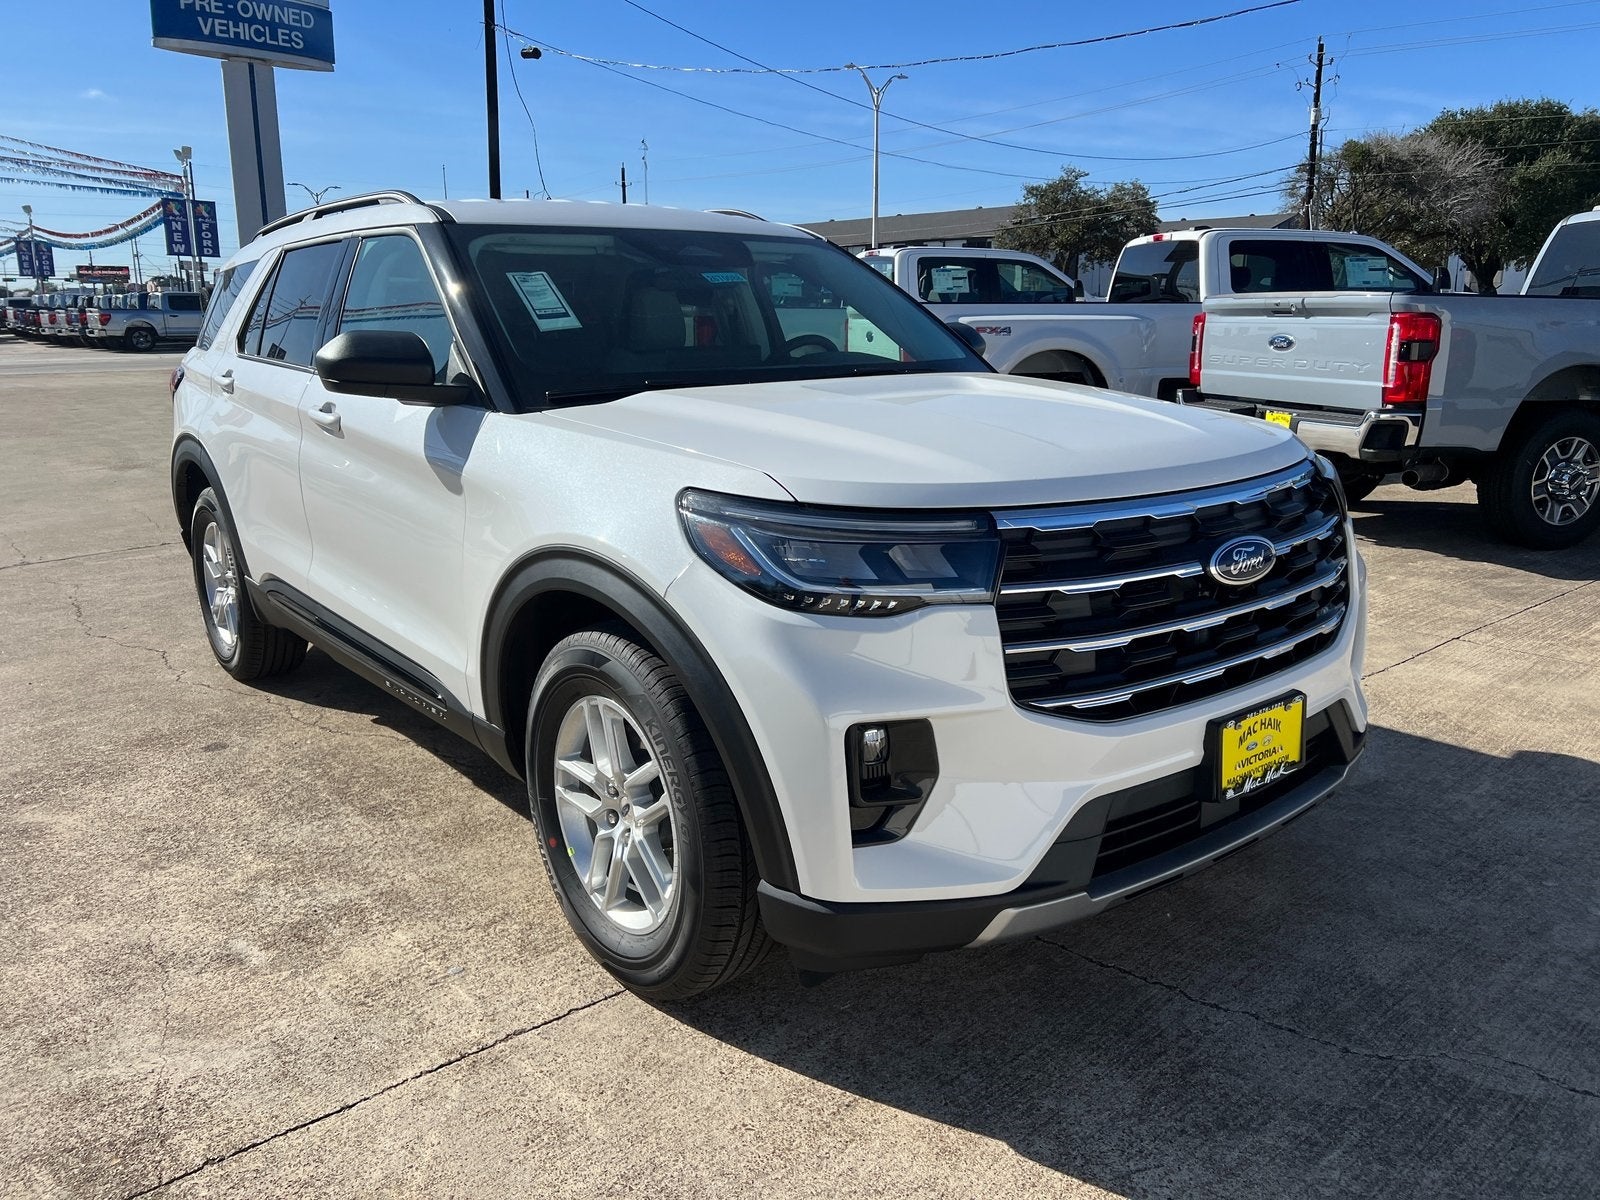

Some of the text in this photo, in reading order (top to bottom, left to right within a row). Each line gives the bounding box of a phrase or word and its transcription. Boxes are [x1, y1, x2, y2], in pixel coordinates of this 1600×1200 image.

[198, 16, 304, 49] VEHICLES
[171, 221, 185, 253] NEW
[201, 223, 213, 255] FORD
[1208, 353, 1371, 374] SUPER DUTY
[1230, 545, 1266, 576] Ford
[1238, 721, 1259, 750] MAC
[1260, 716, 1282, 733] HAIK
[644, 716, 690, 822] KINERGY
[1240, 746, 1278, 770] VICTORIA
